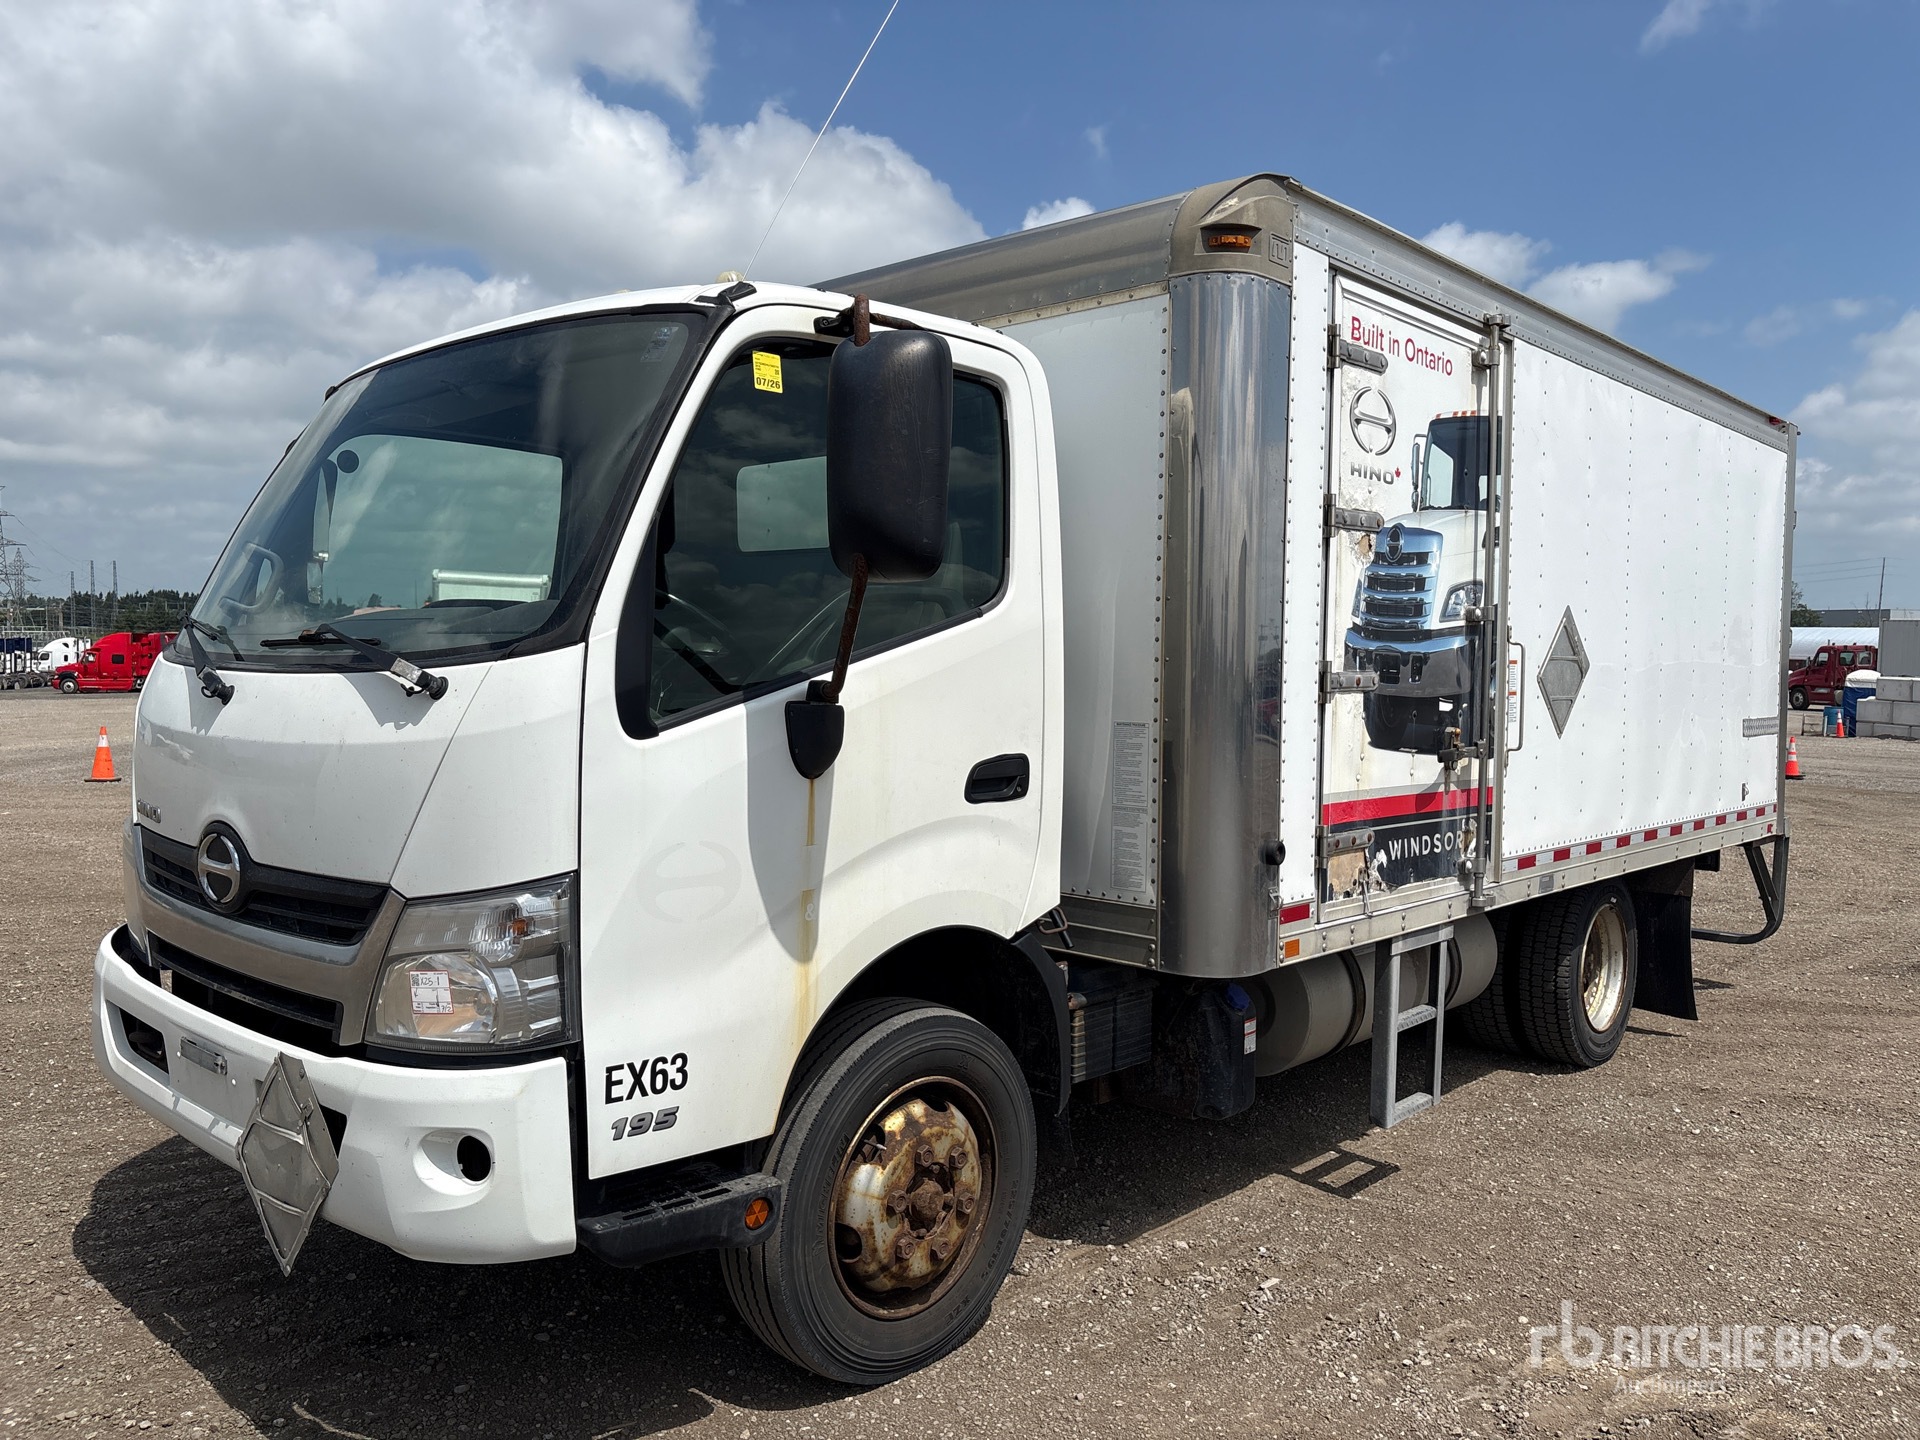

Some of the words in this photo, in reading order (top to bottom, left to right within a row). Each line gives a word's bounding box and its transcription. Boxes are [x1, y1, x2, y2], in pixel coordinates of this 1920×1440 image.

[1350, 316, 1385, 352] Built
[1388, 331, 1401, 357] in
[1404, 338, 1453, 376] Ontario
[756, 376, 781, 390] 07/26
[1350, 461, 1394, 485] HINO
[1388, 830, 1463, 861] WINDSOR
[605, 1052, 689, 1105] EX63
[611, 1106, 680, 1141] 195
